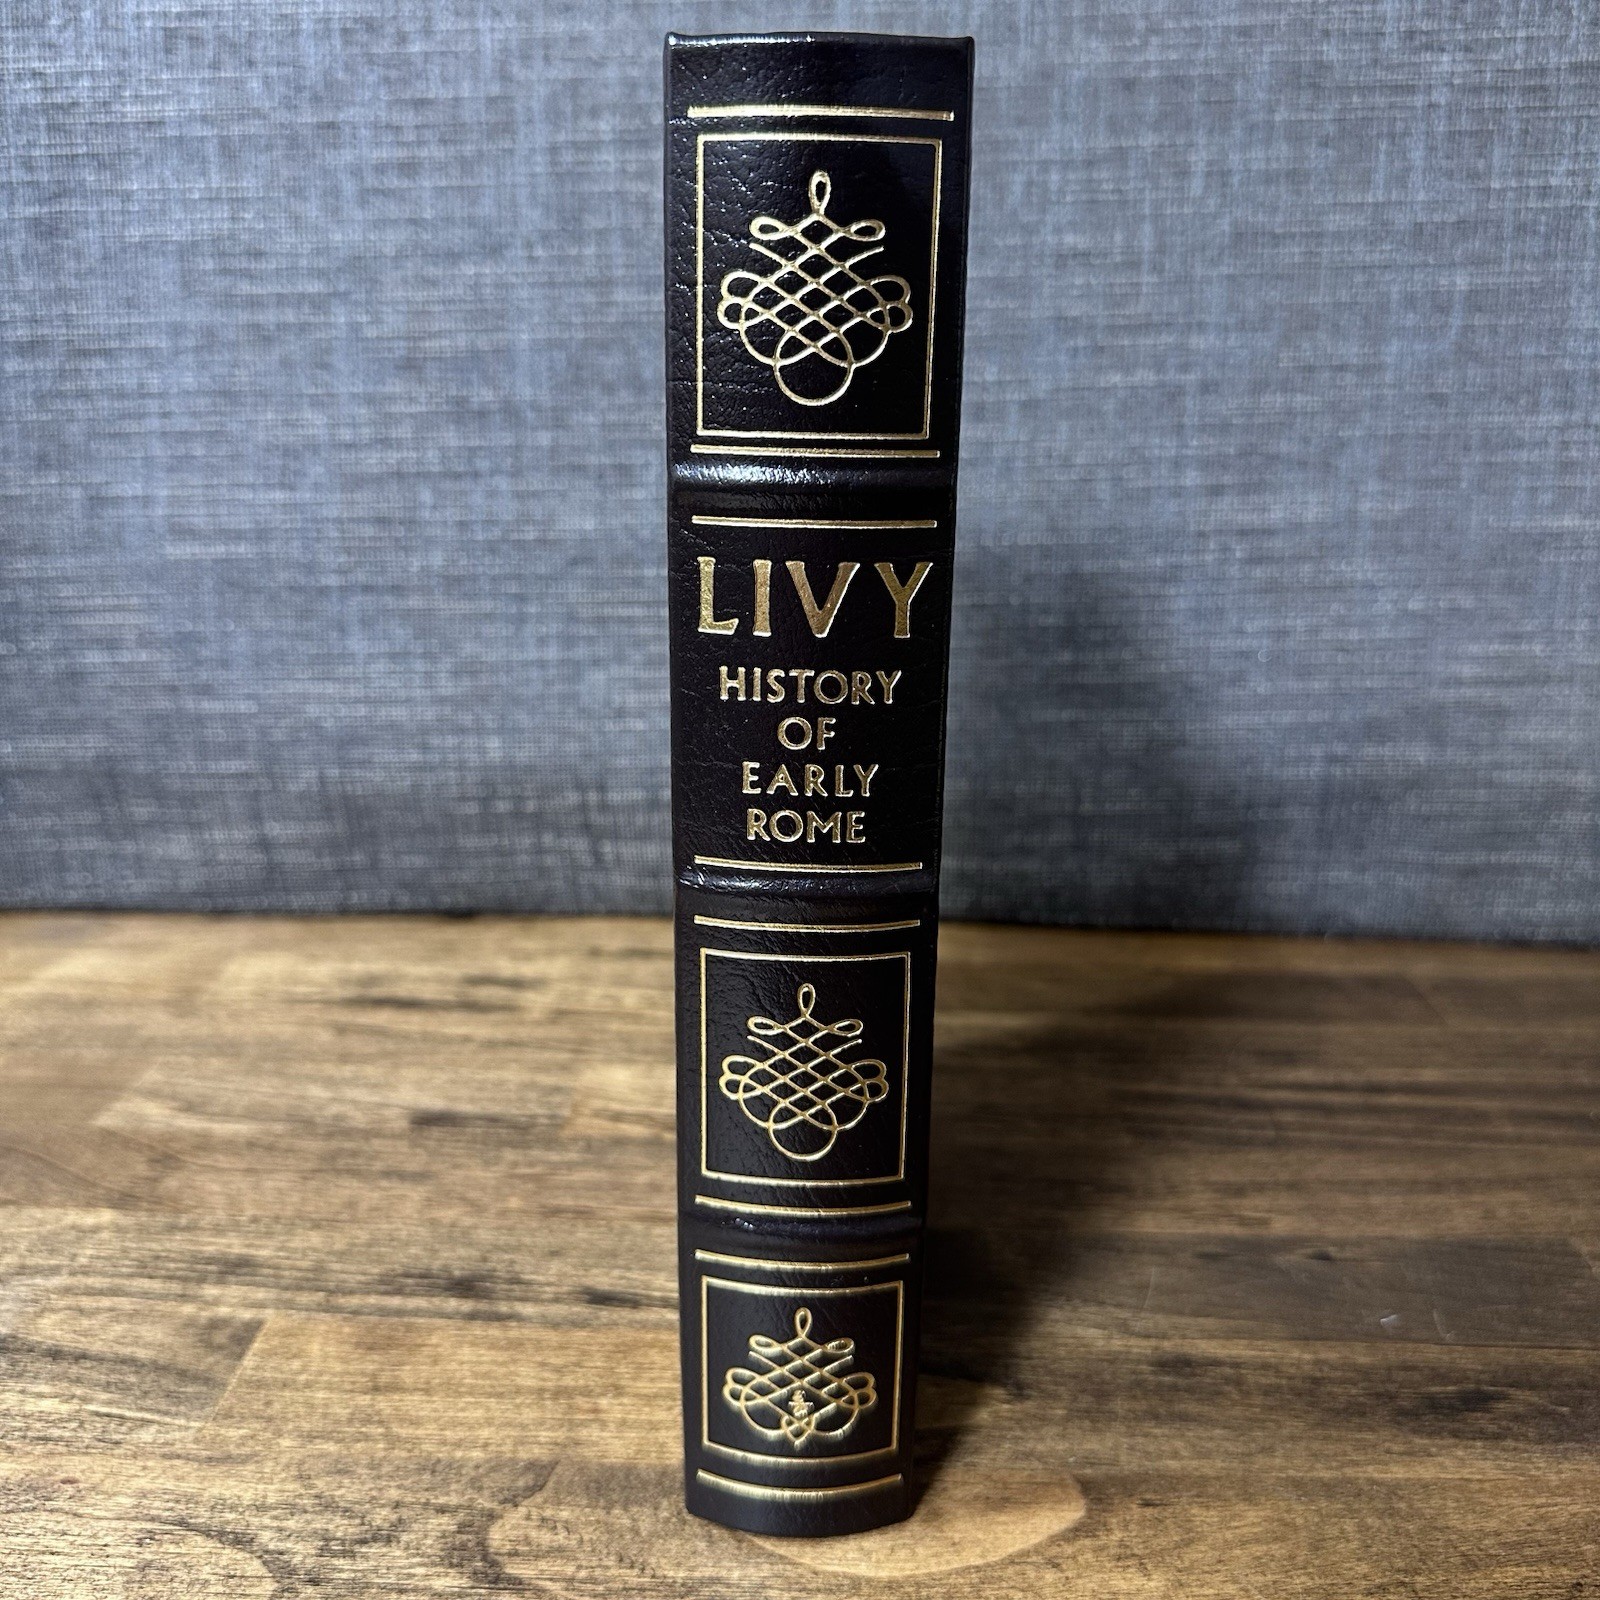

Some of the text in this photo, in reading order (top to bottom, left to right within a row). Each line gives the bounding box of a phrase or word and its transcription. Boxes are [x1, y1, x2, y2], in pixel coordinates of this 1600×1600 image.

[696, 556, 934, 639] LIVY
[718, 665, 902, 705] HISTORY
[777, 716, 837, 751] OF
[741, 760, 879, 798] EARLY
[746, 808, 866, 844] ROME
